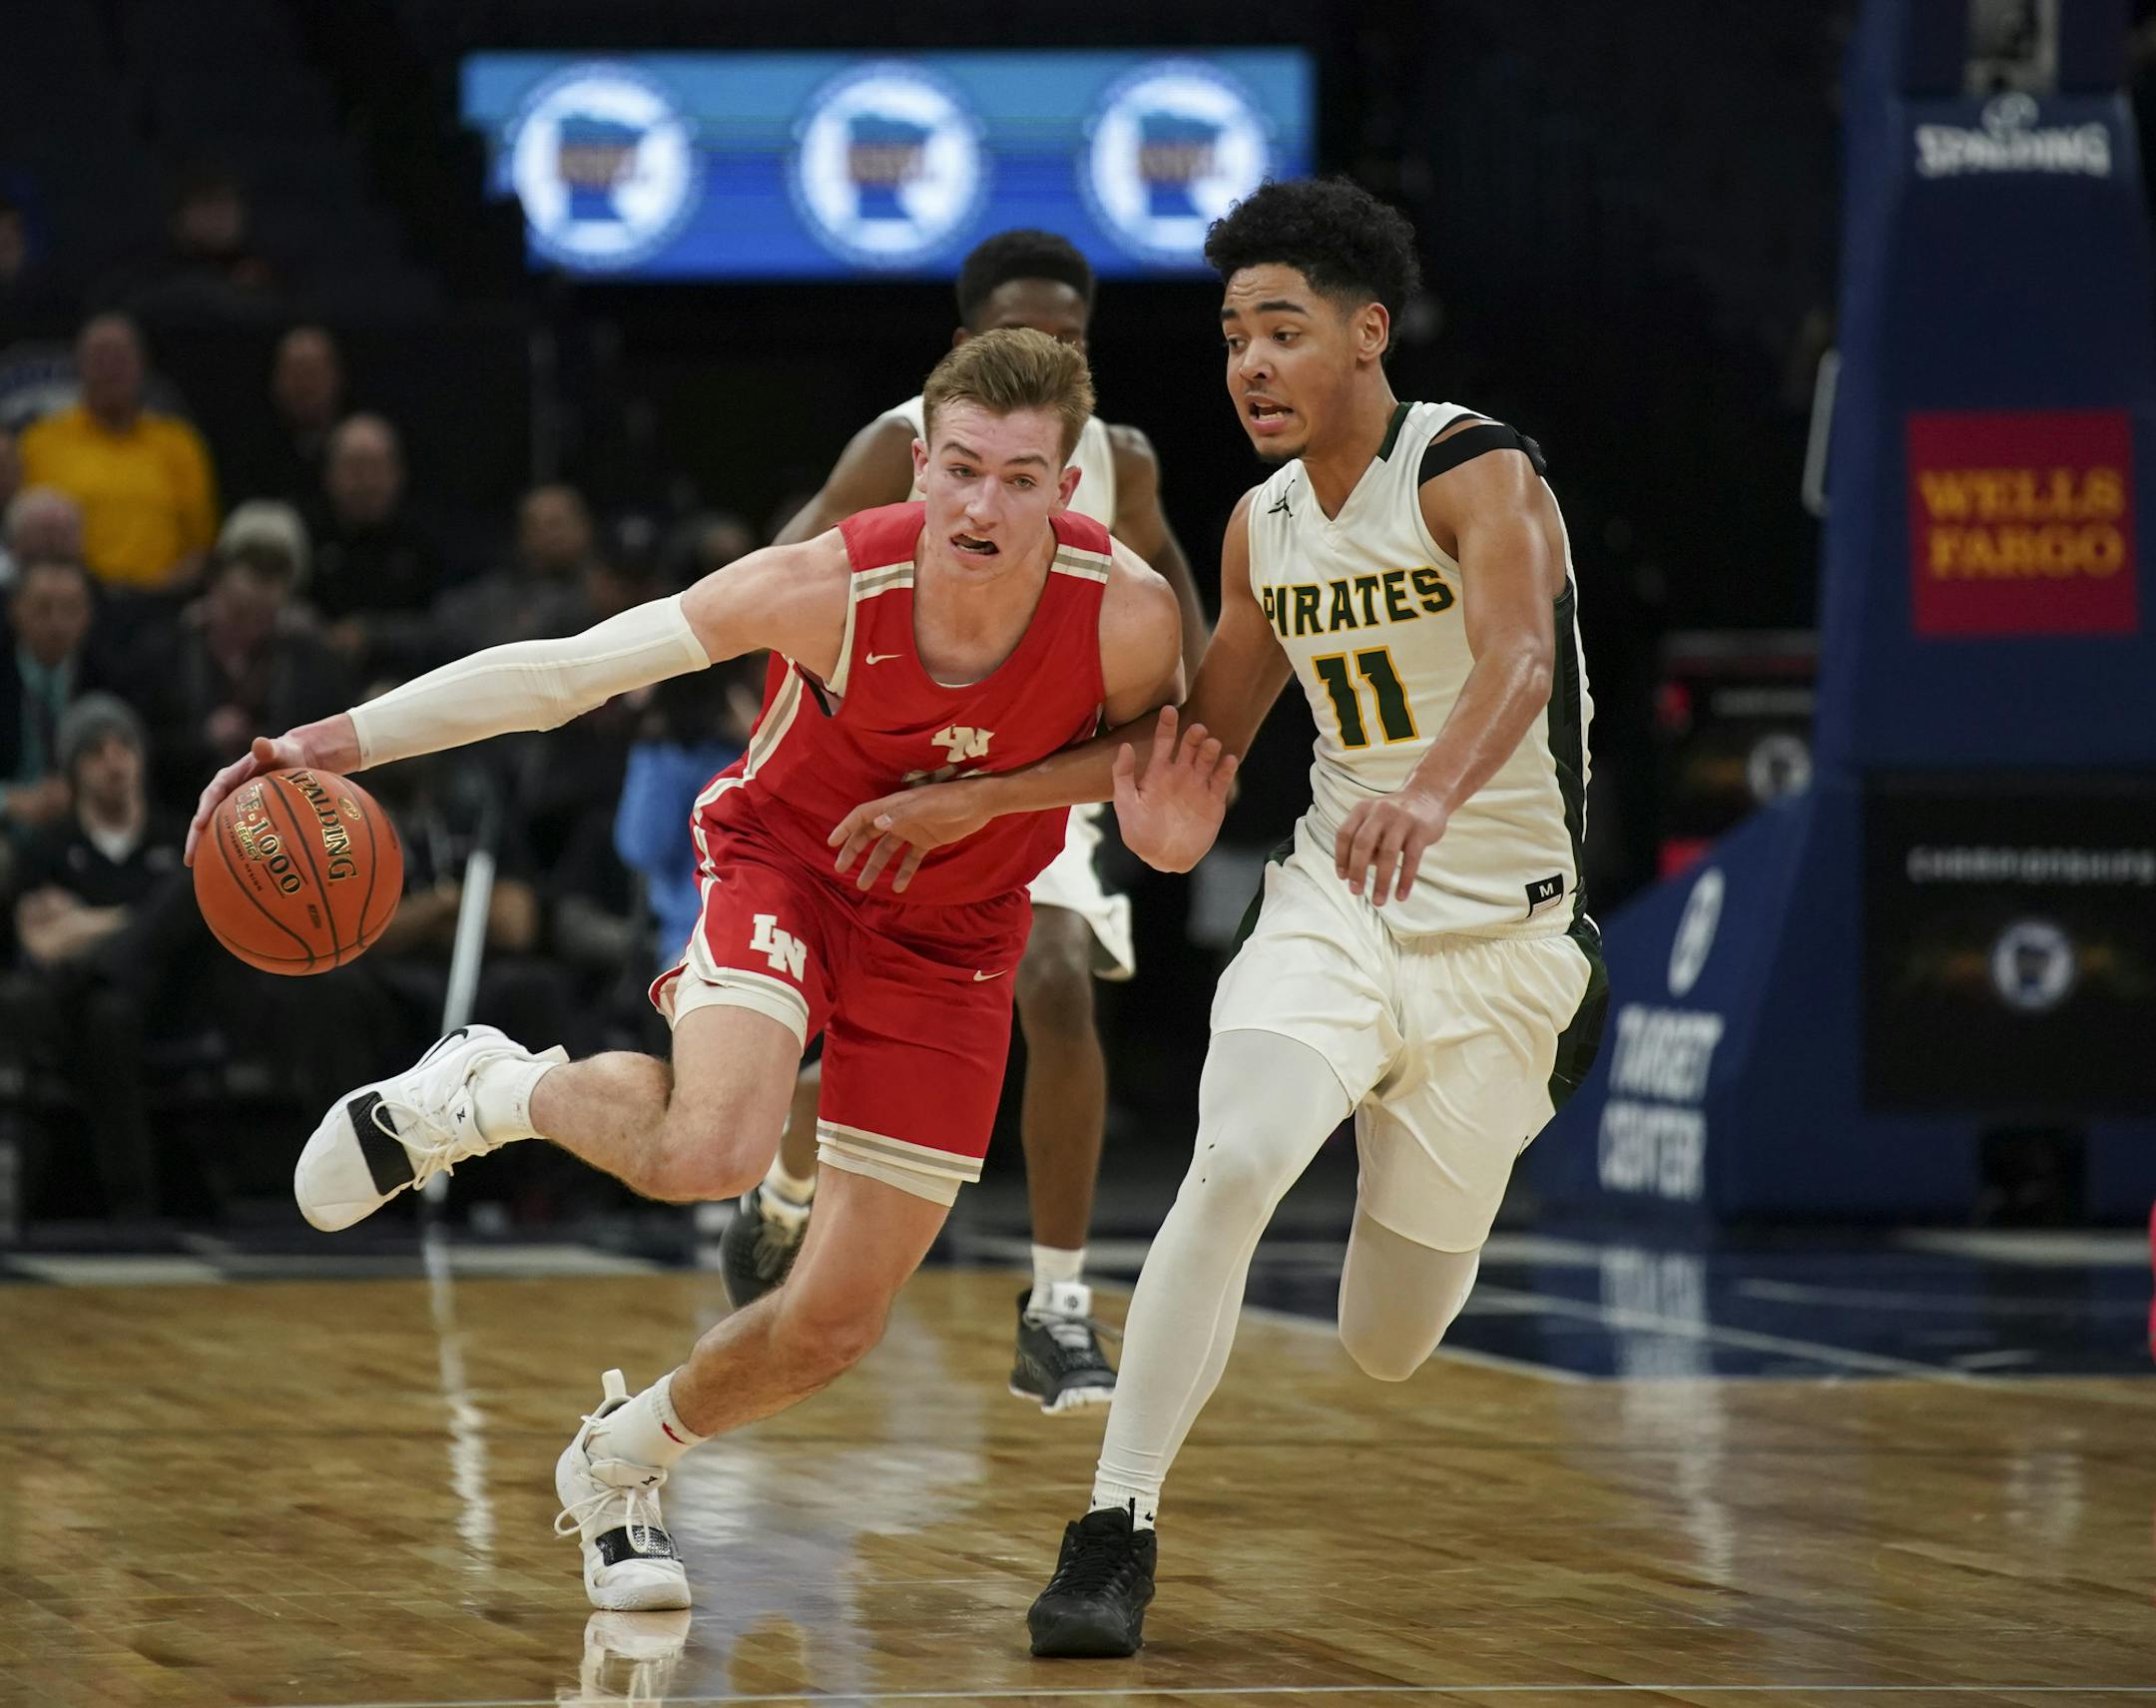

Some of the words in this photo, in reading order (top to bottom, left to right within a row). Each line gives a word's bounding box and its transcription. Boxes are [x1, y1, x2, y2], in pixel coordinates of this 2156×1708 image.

[1920, 468, 2125, 521] WELLS
[1928, 525, 2125, 579] FARGO
[1262, 566, 1457, 638] PIRATES
[1311, 645, 1420, 750] 11
[278, 770, 358, 882] SPALDING
[1538, 882, 1554, 897] M
[749, 913, 808, 983] LN
